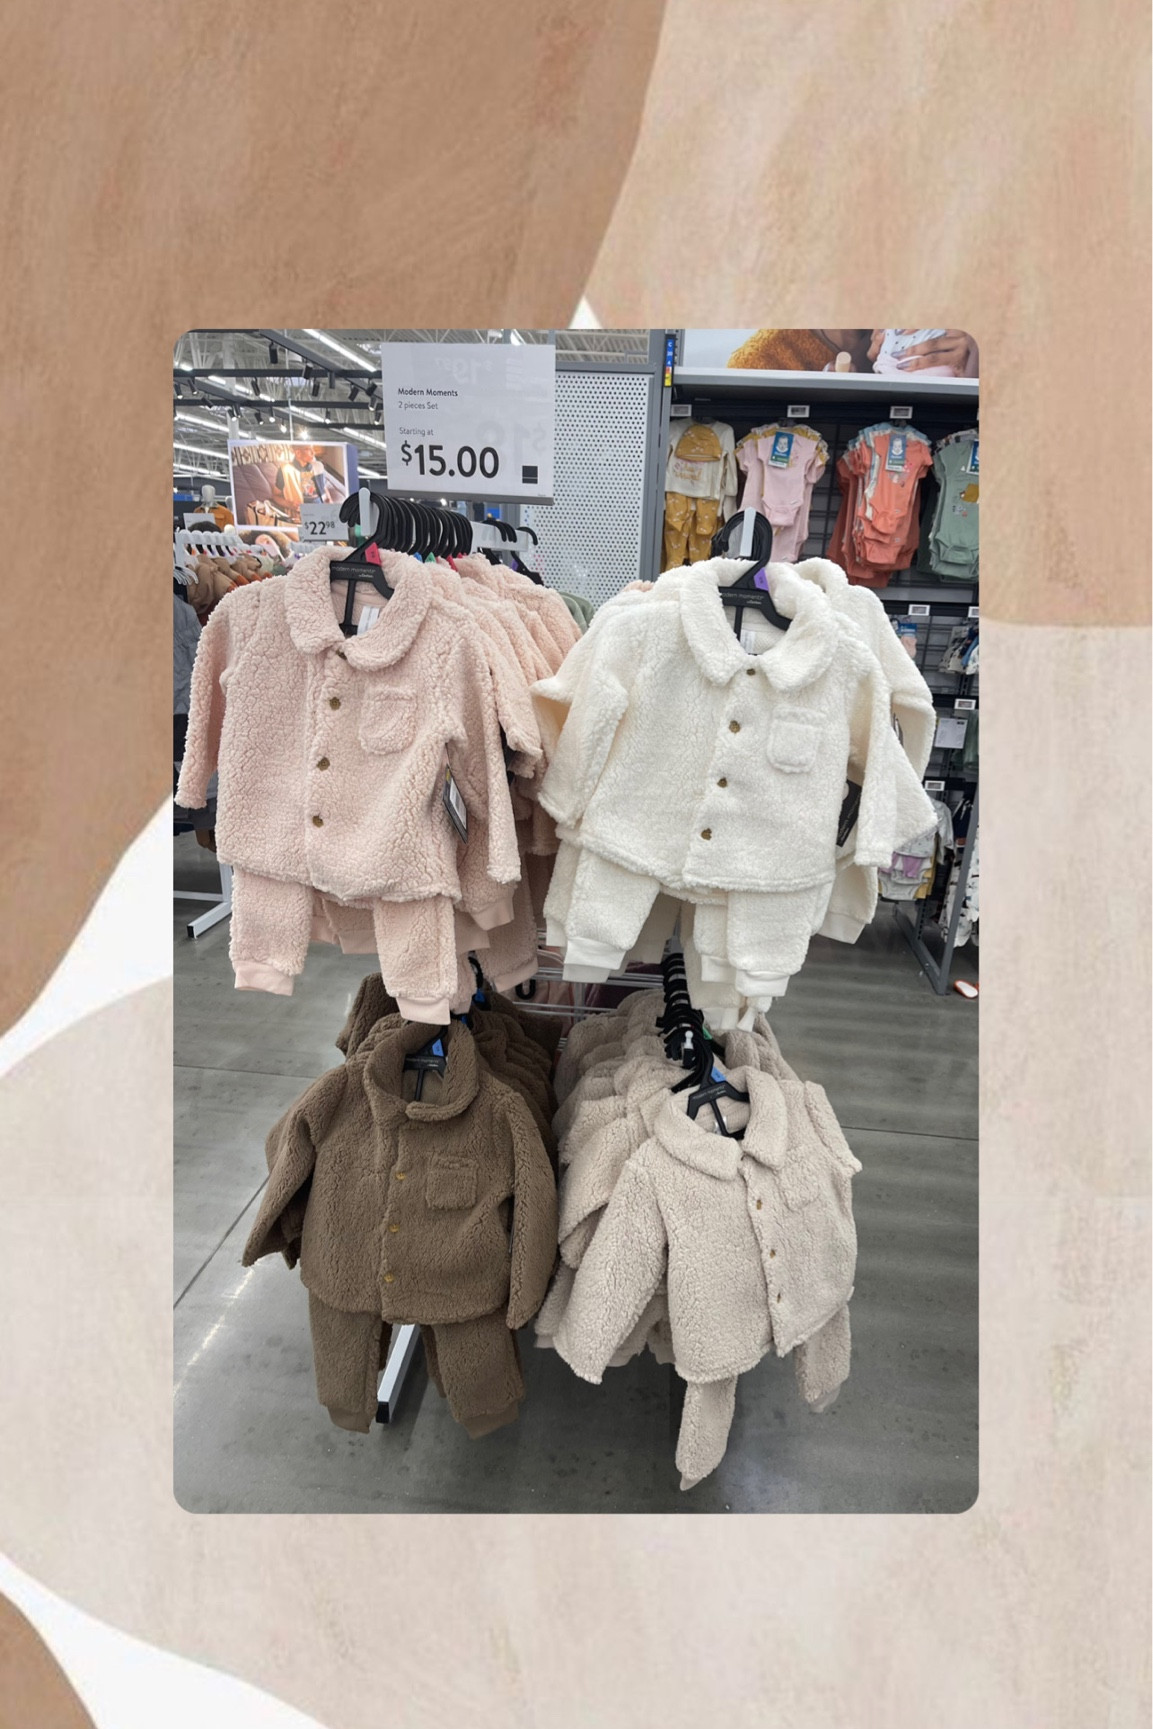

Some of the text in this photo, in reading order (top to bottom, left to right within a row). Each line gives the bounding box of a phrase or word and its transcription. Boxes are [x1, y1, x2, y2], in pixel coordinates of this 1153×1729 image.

[398, 388, 459, 397] Modern Moments
[398, 401, 439, 411] 2 pieces Set
[399, 427, 426, 438] Starting
[401, 440, 499, 479] $15.00
